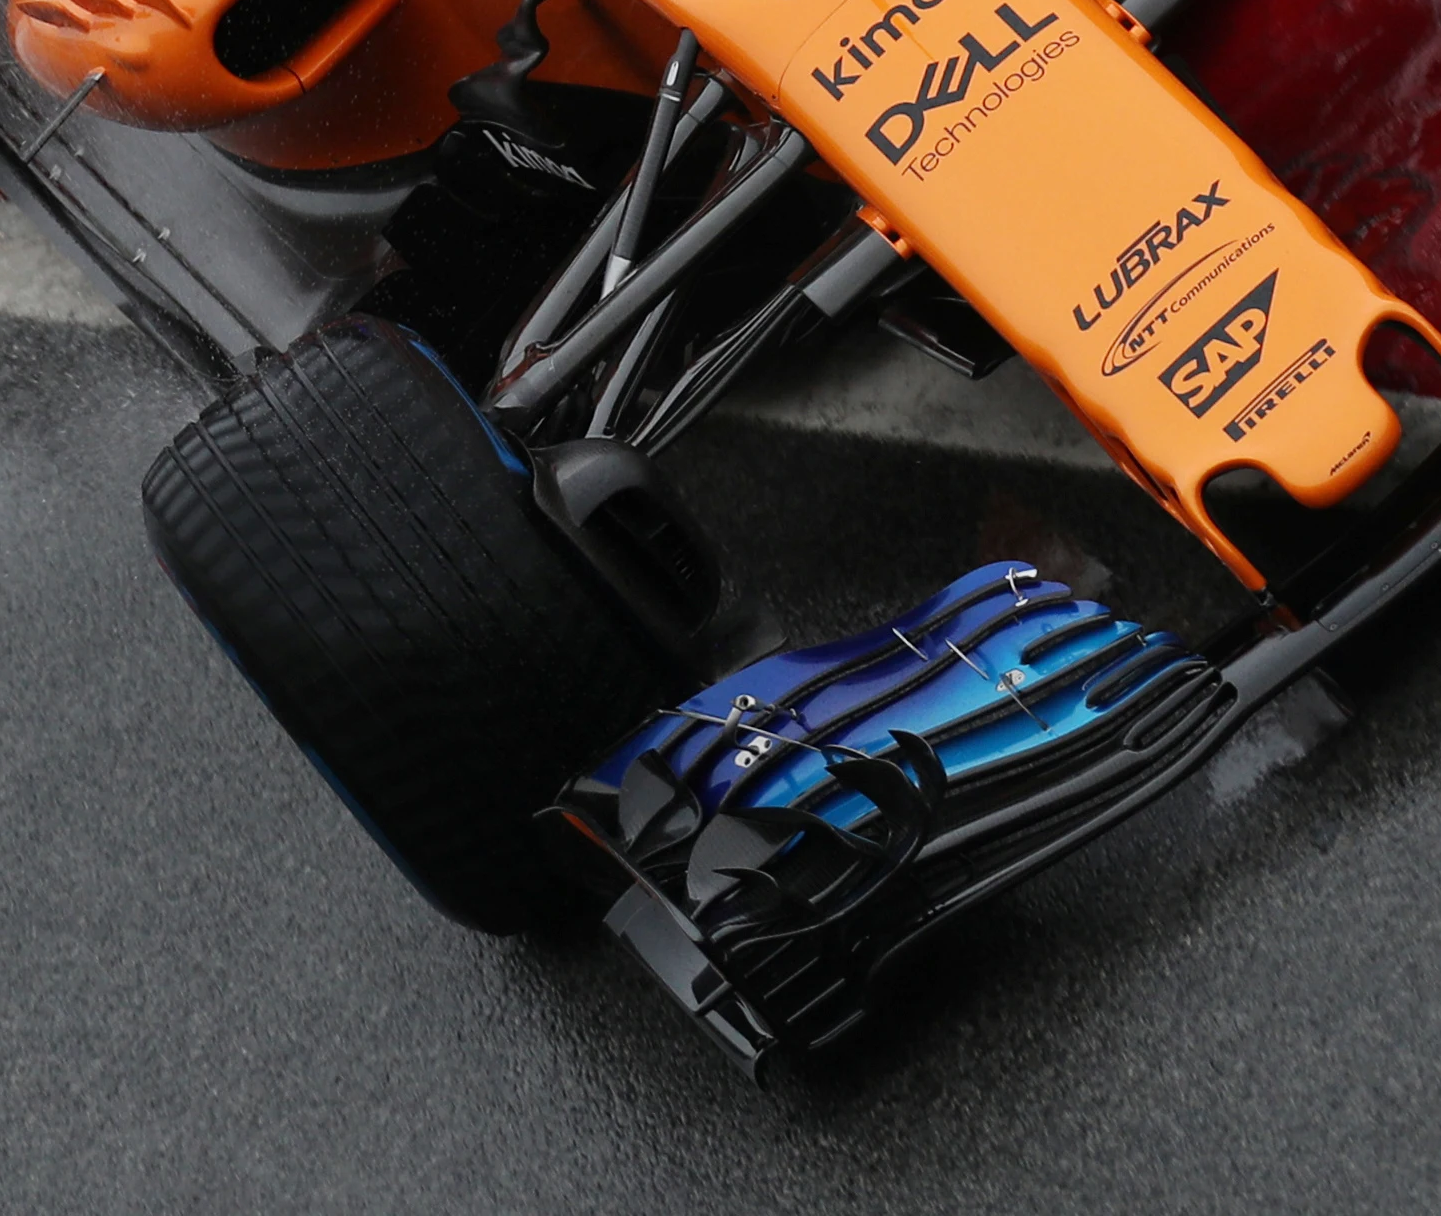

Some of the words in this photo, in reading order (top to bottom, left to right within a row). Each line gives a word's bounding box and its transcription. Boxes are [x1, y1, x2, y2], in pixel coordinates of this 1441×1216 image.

[865, 3, 1060, 166] DELL
[901, 30, 1081, 182] Technologies
[1072, 179, 1231, 331] LUBRAX
[1128, 307, 1169, 352] NTT
[1169, 222, 1276, 314] Communications
[1170, 306, 1270, 408] SAP
[1222, 337, 1336, 442] PIRELLI
